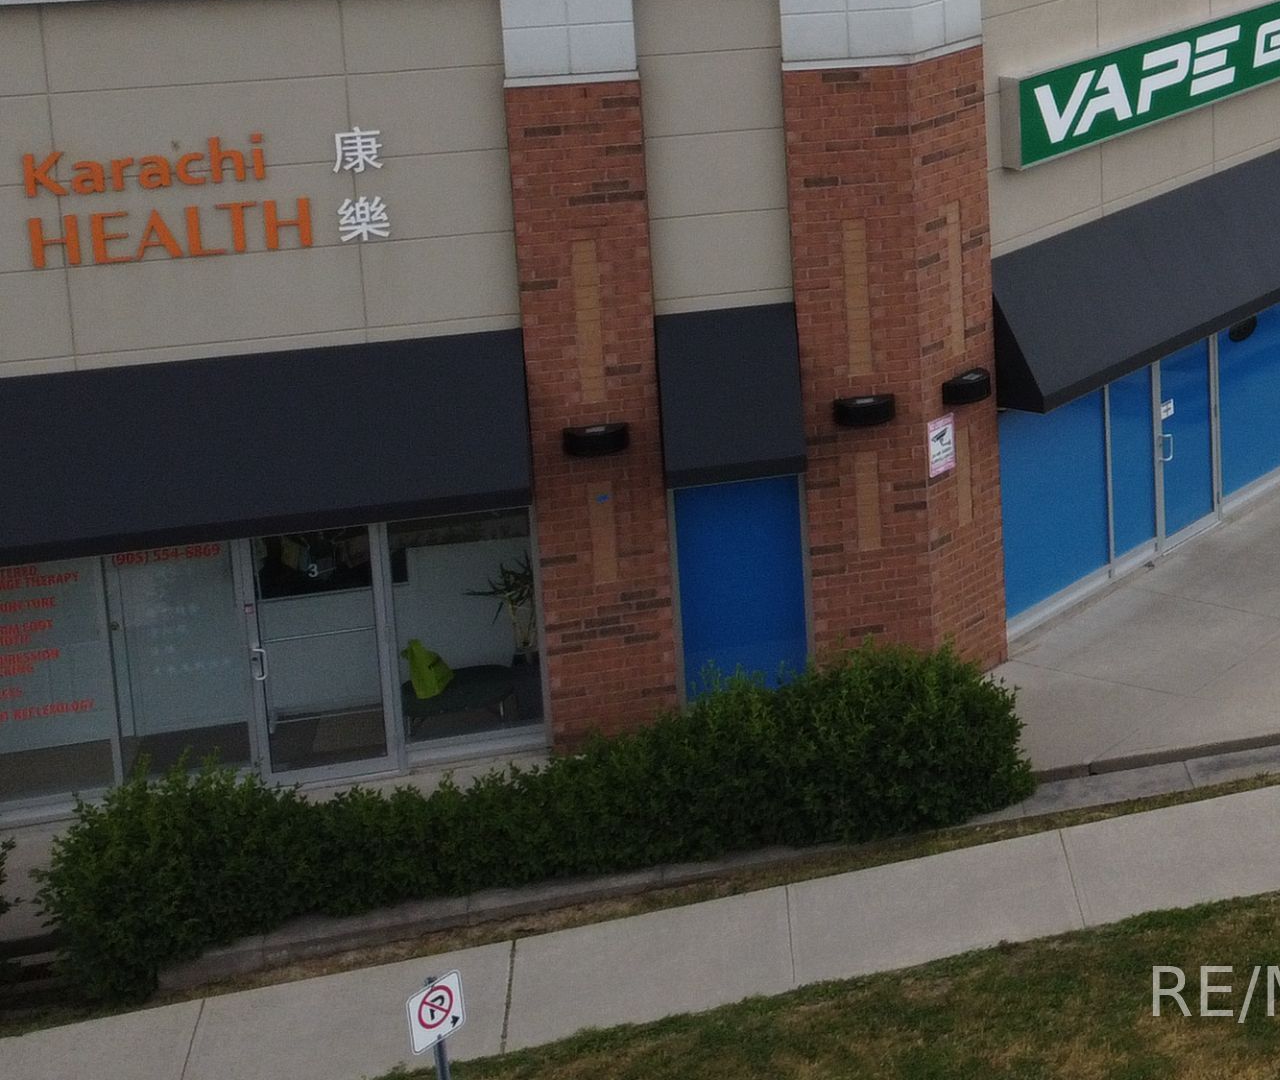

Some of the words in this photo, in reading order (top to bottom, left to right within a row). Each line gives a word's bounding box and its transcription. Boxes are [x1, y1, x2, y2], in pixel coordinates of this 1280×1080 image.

[1033, 24, 1241, 144] VAPE
[22, 132, 266, 199] Karachi
[26, 197, 314, 269] HEALTH
[112, 552, 149, 567] (905)
[307, 563, 319, 578] 3
